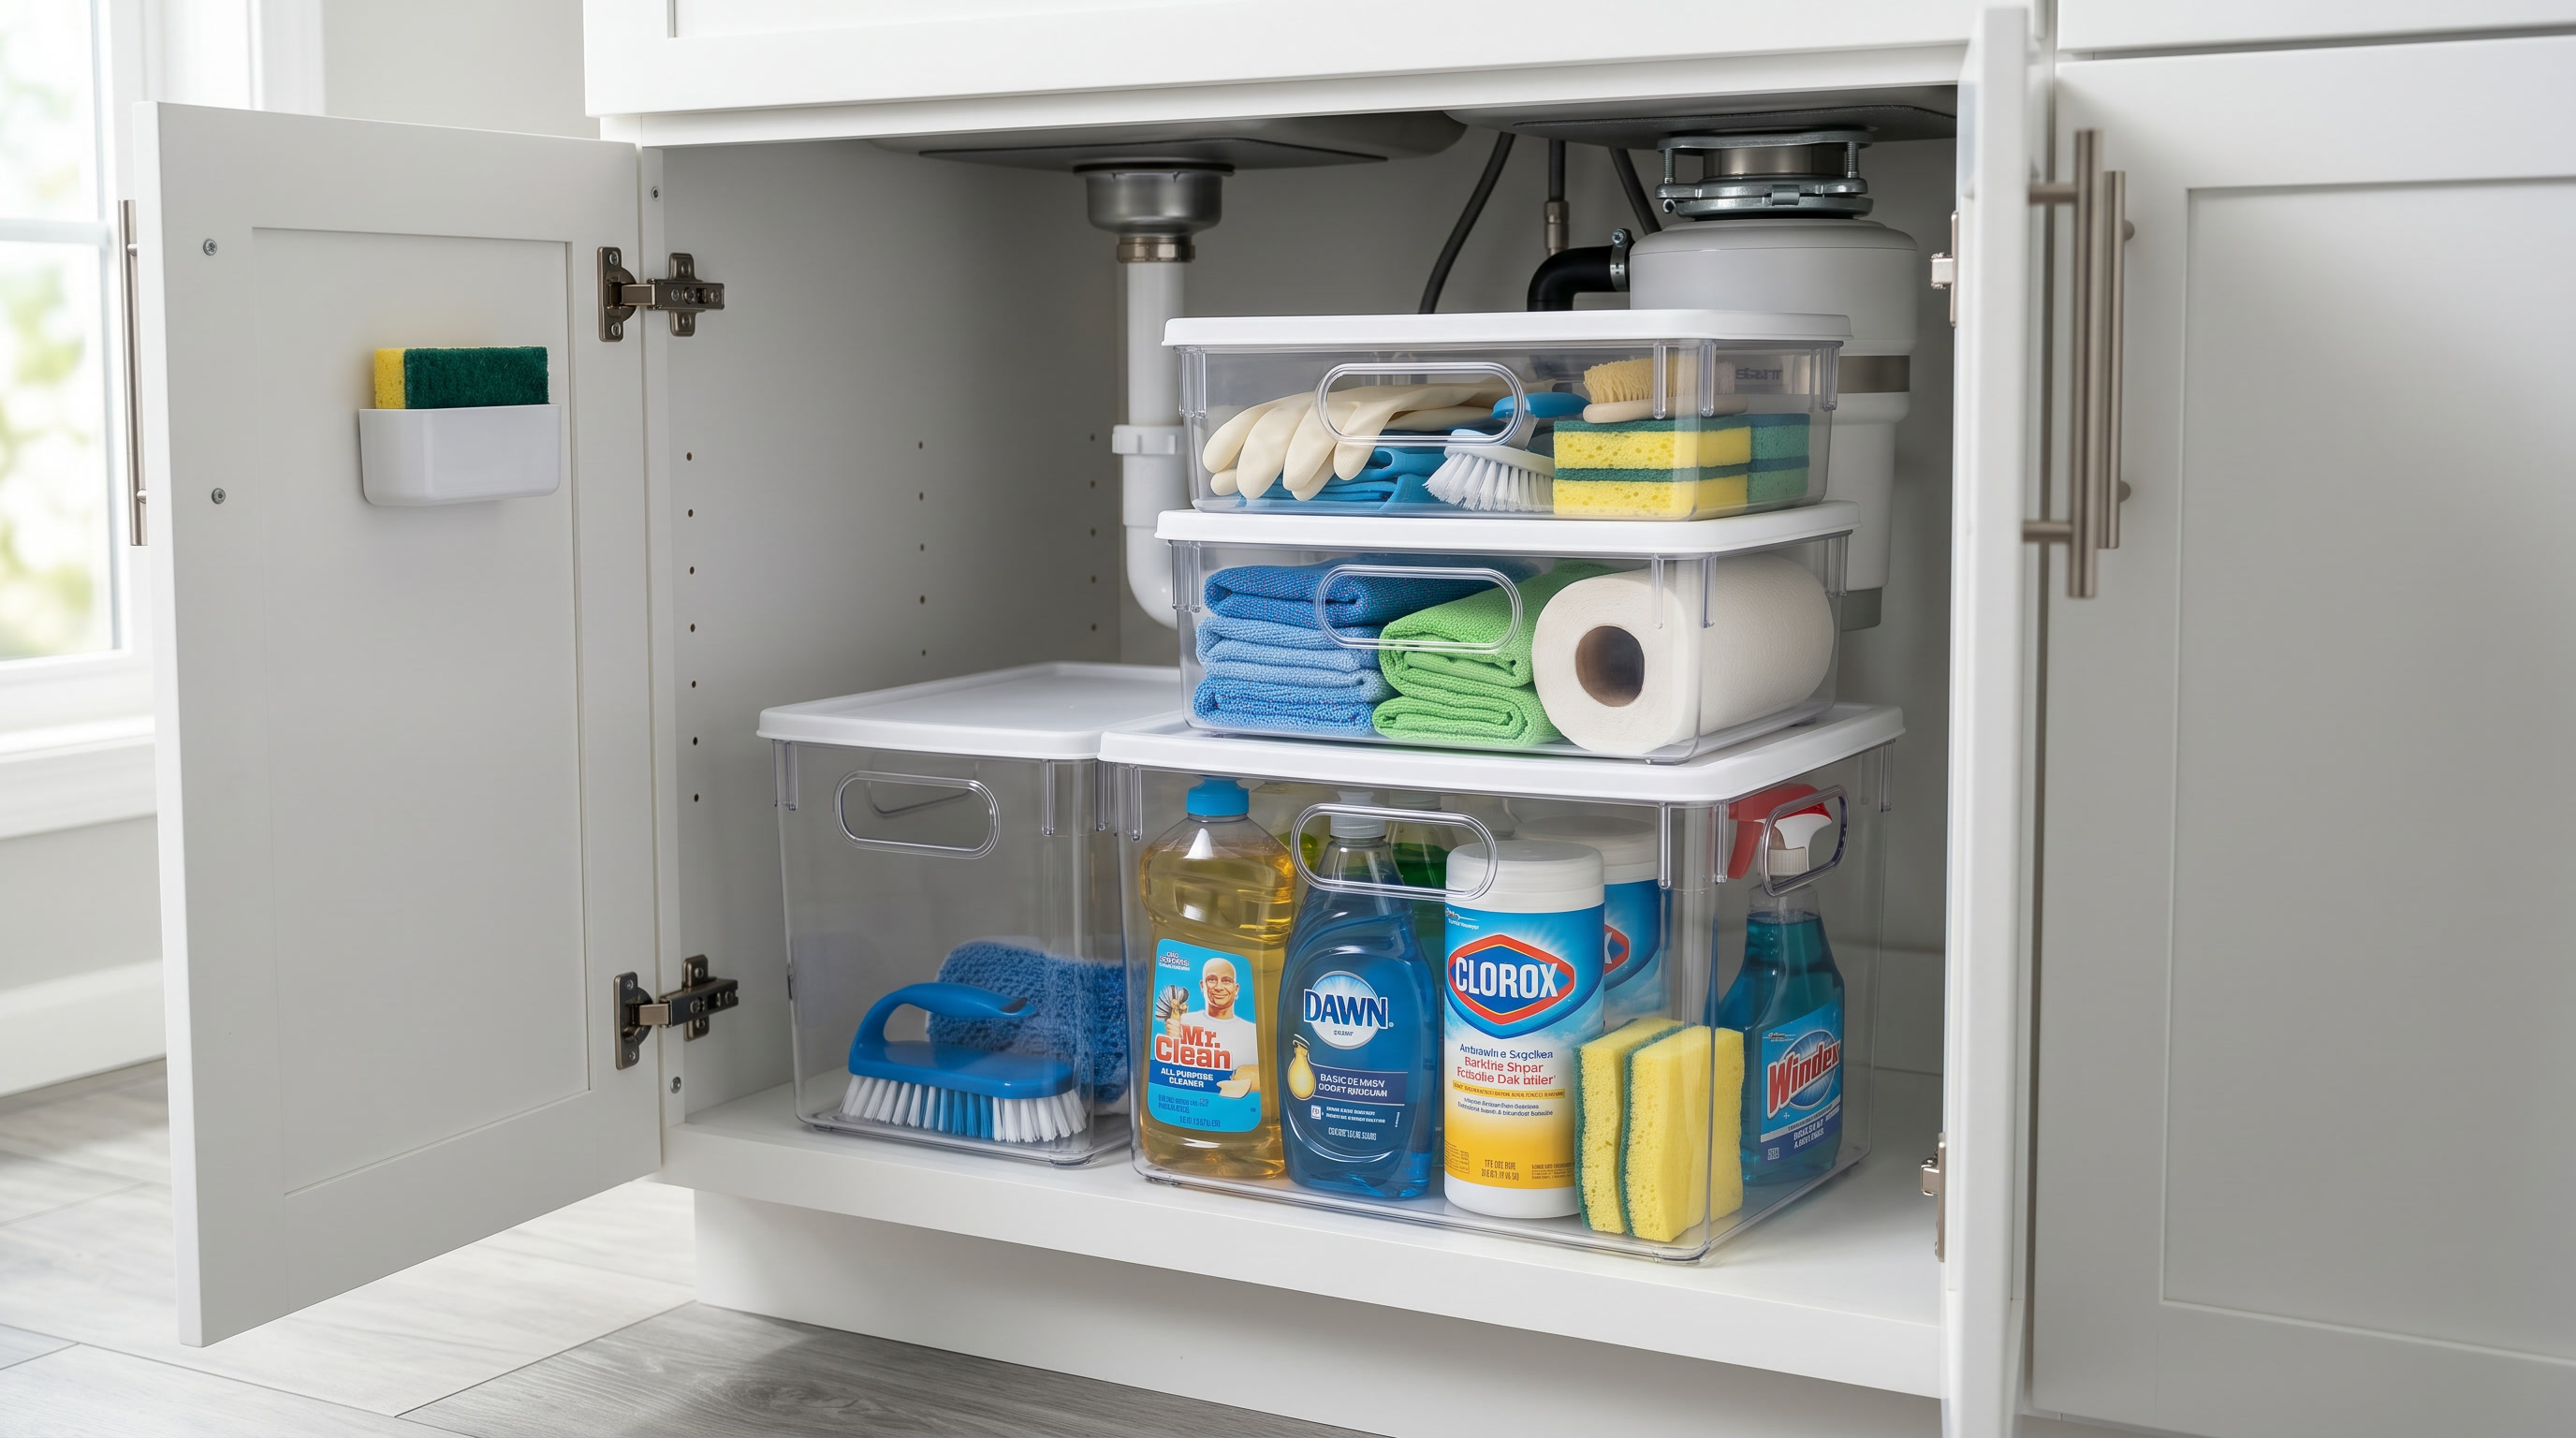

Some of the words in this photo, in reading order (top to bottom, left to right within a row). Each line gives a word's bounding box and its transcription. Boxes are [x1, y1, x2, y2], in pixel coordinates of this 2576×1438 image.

[1456, 956, 1559, 999] CLOROX
[1304, 988, 1388, 1029] DAWN
[1180, 1024, 1221, 1049] Mr.
[1155, 1035, 1231, 1069] Clean
[1161, 1067, 1176, 1077] ALL
[1168, 1077, 1205, 1088] CLEANER
[1320, 1073, 1347, 1085] BASIC
[1769, 1040, 1840, 1115] Windex
